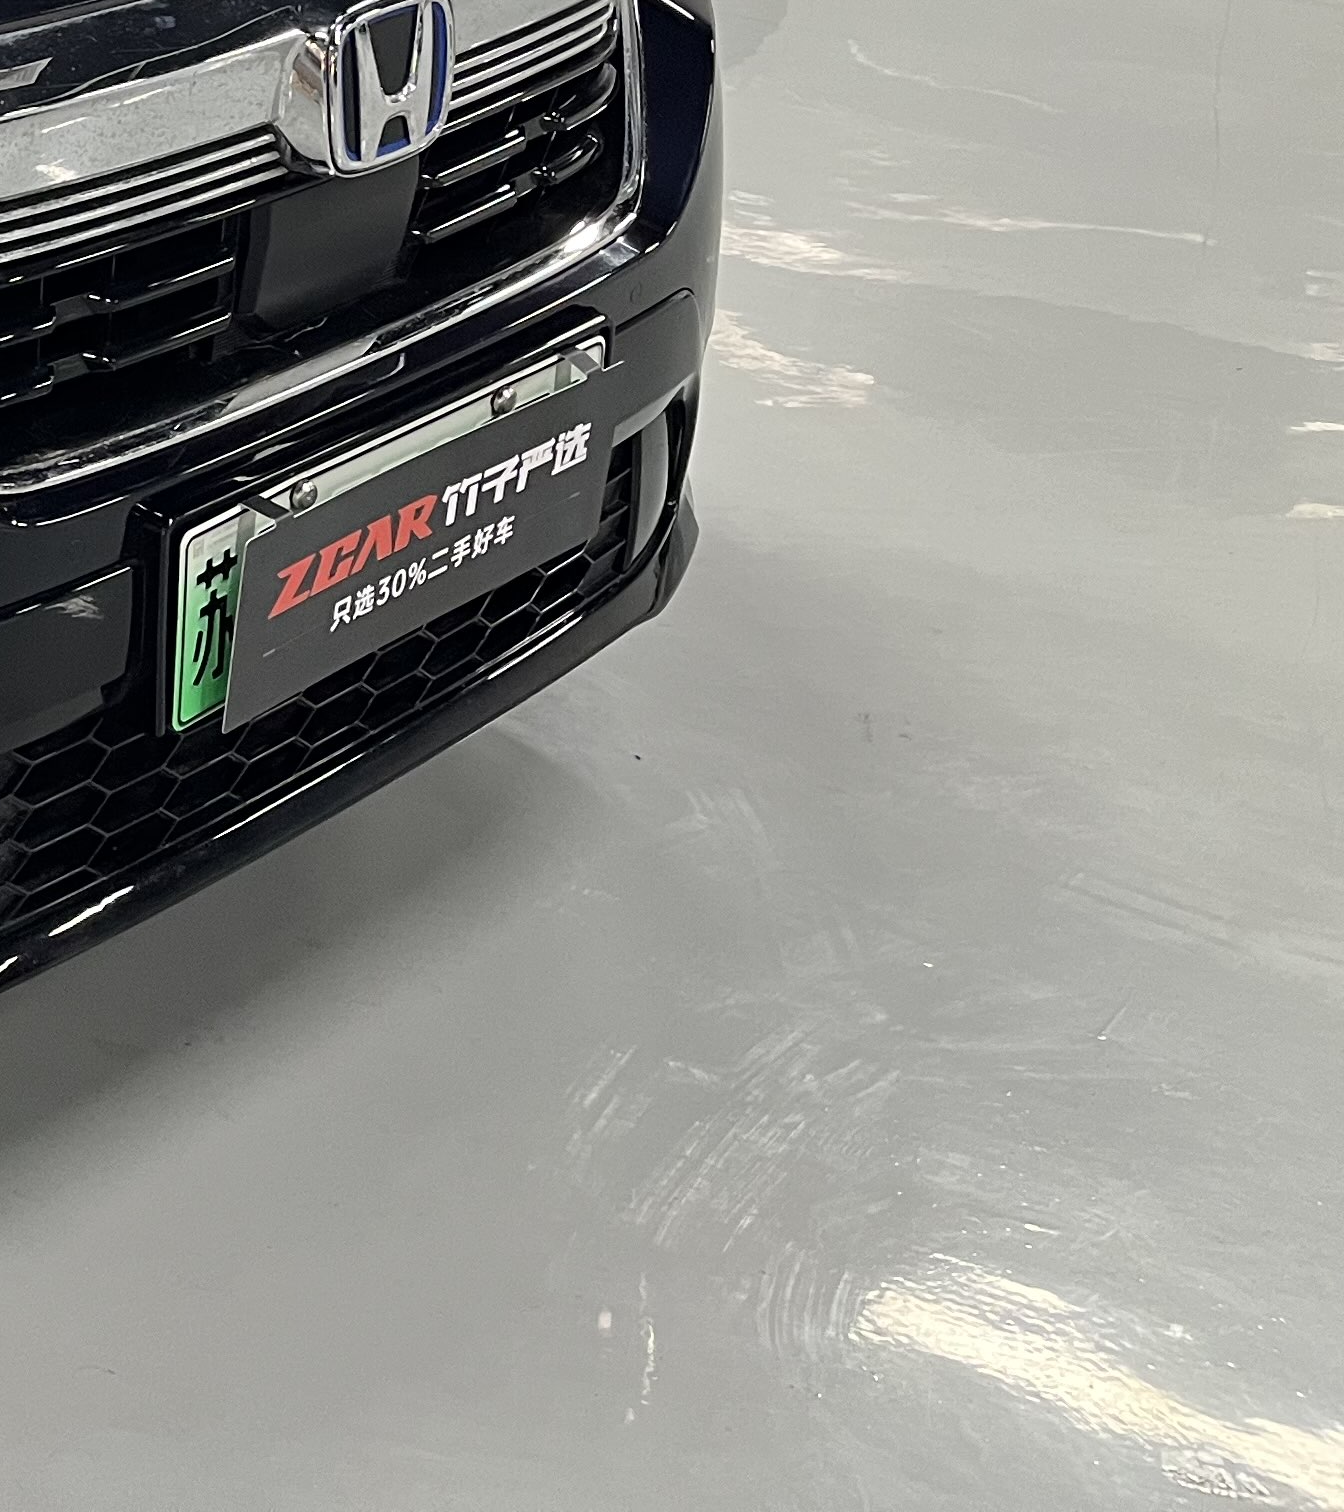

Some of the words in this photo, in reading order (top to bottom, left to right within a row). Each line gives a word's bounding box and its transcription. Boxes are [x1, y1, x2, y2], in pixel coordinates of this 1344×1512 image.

[192, 548, 238, 686] 苏
[267, 493, 438, 620] ZCAR
[330, 515, 515, 632] 只选30%二手好车
